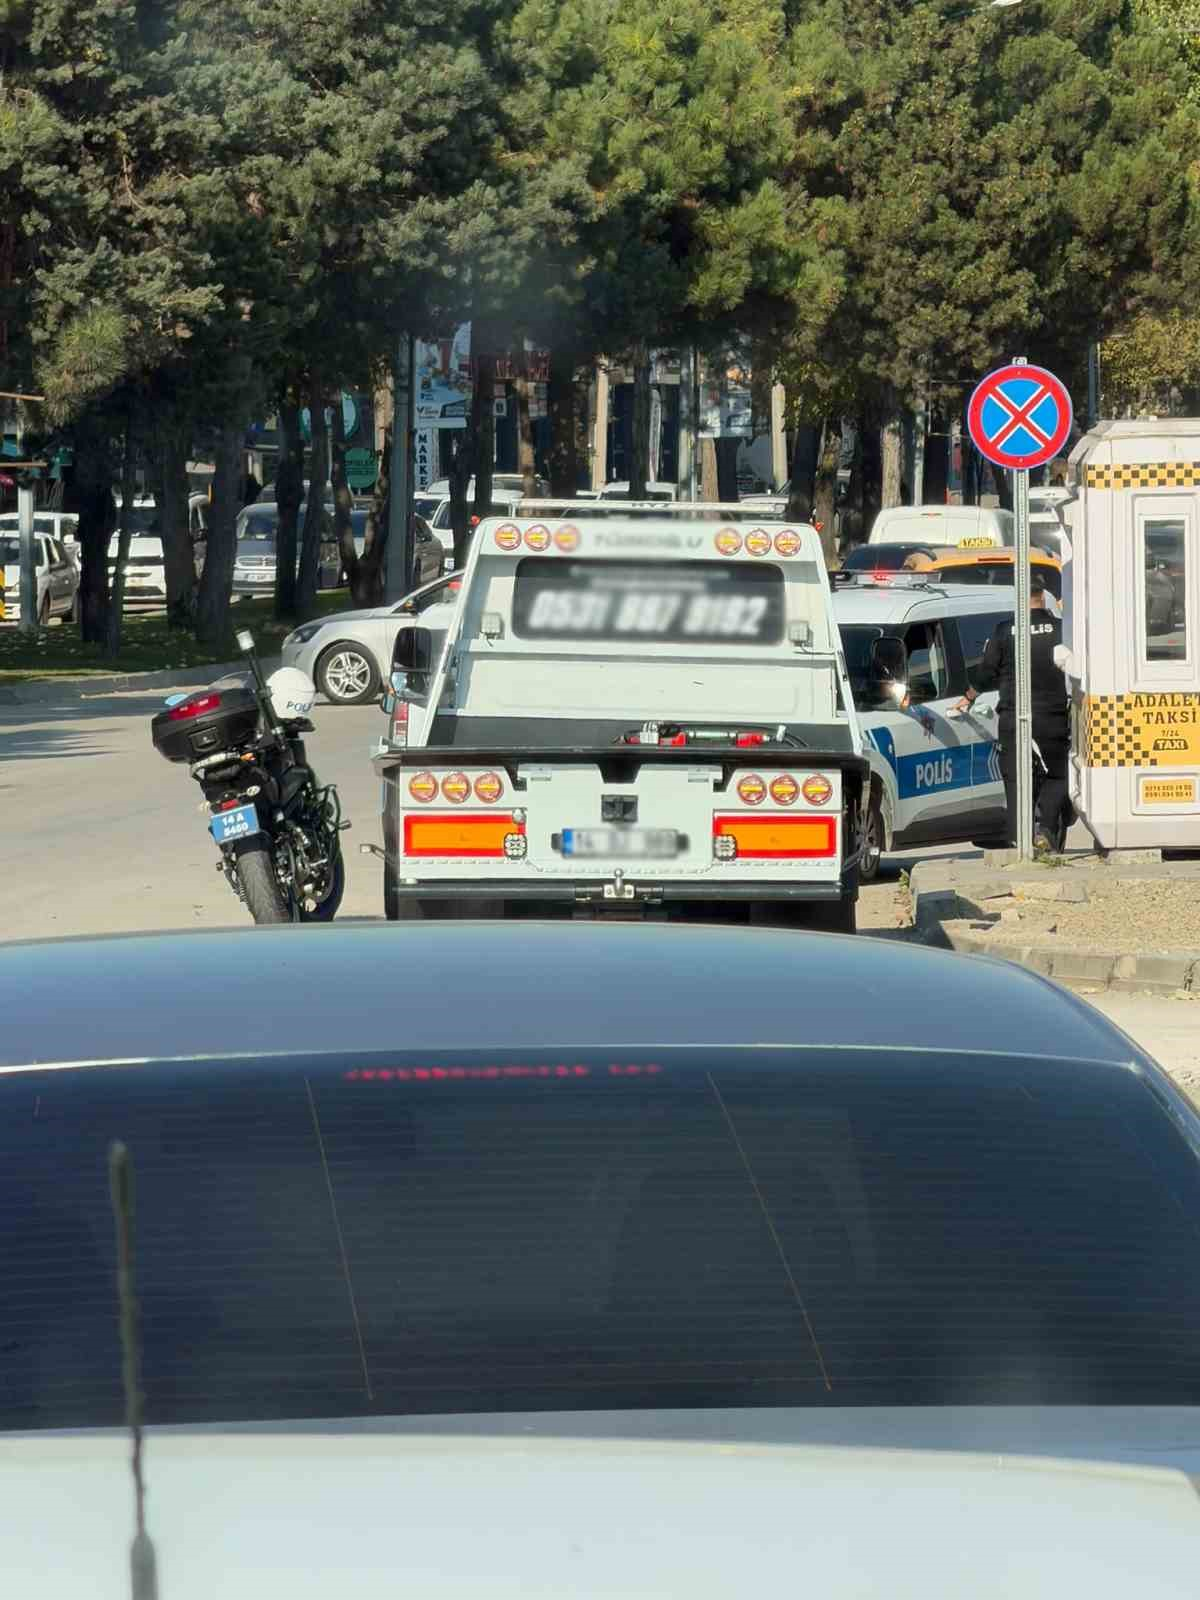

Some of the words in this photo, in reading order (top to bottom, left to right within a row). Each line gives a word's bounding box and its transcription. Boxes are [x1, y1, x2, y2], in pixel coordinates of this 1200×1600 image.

[1011, 623, 1053, 635] LİS
[1142, 708, 1197, 724] TAKSİ
[1157, 740, 1185, 749] TAXI
[915, 753, 953, 789] POLİS
